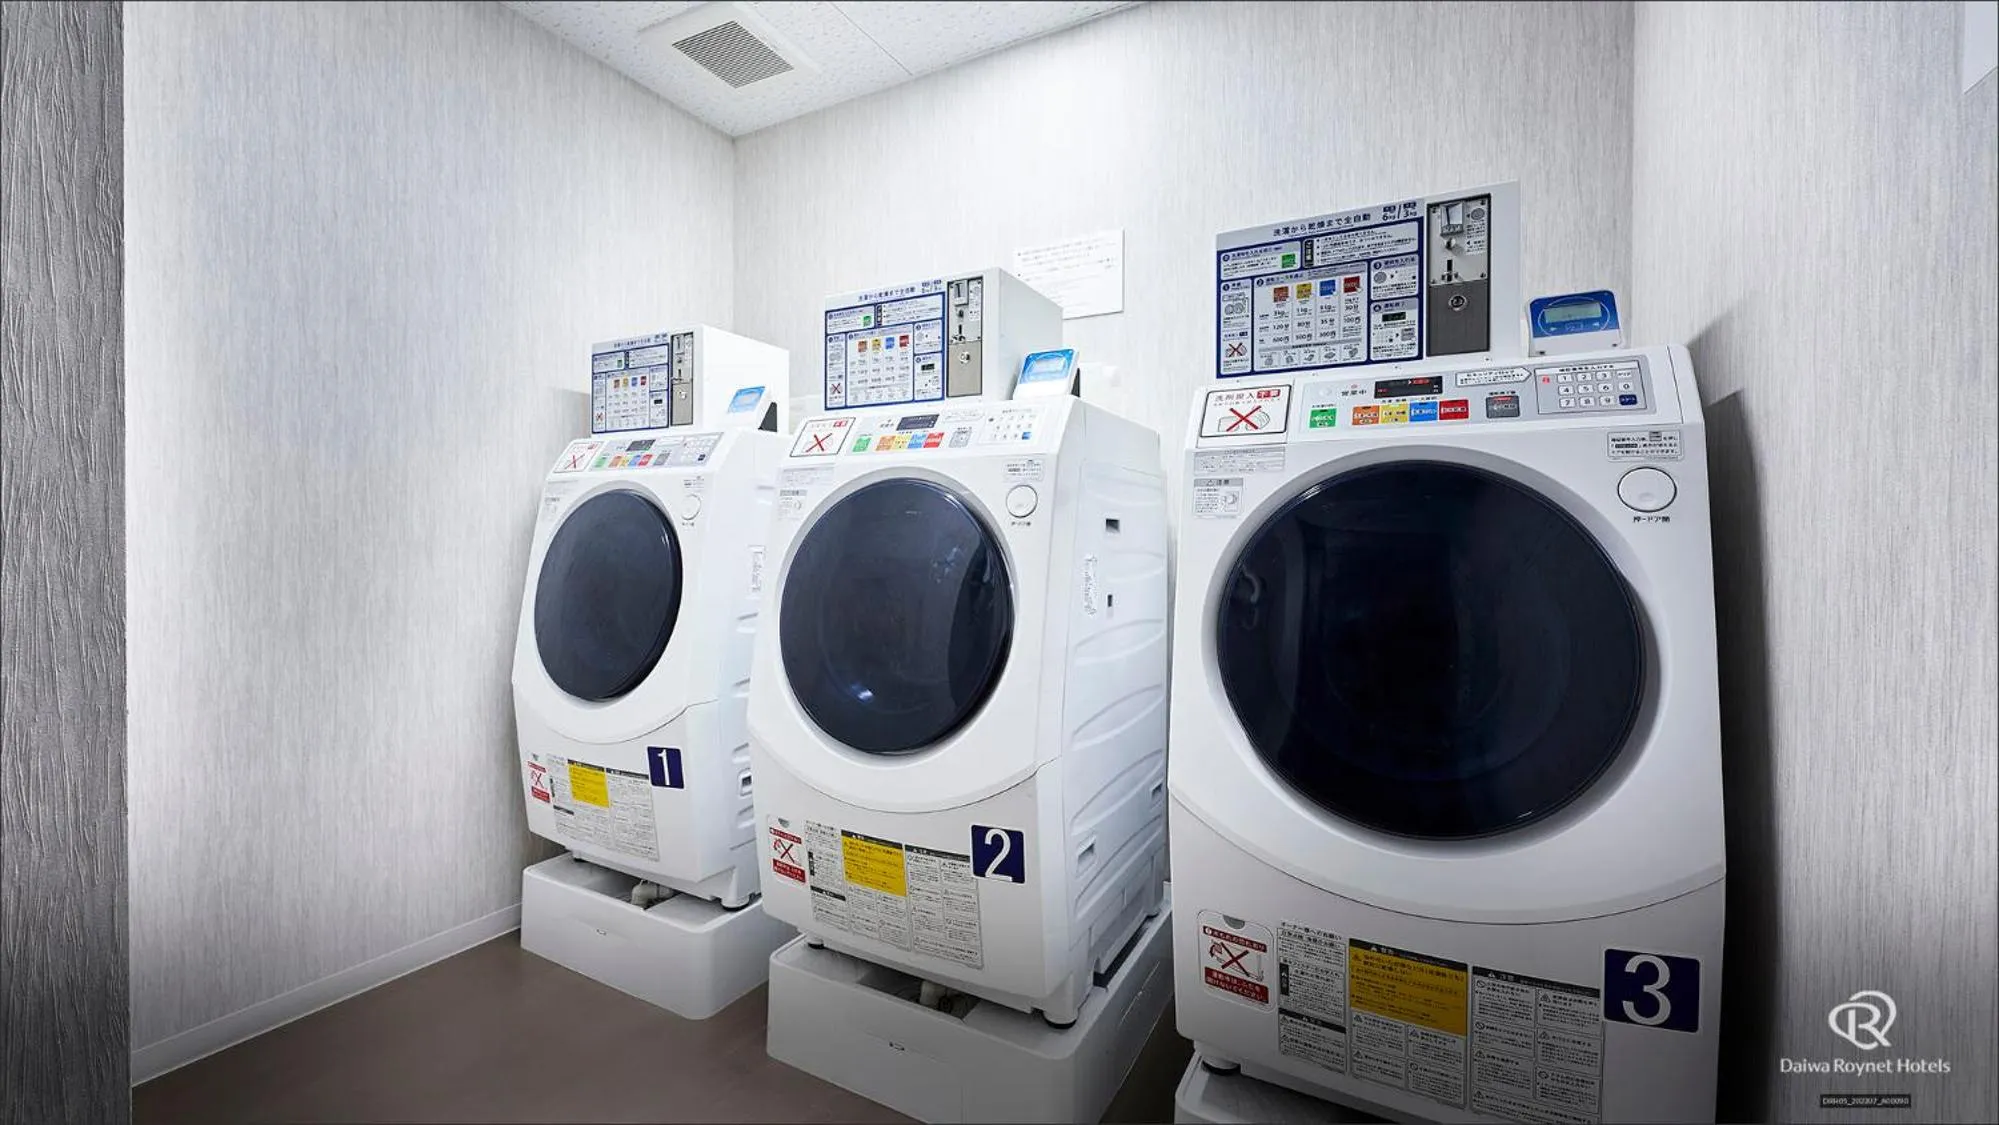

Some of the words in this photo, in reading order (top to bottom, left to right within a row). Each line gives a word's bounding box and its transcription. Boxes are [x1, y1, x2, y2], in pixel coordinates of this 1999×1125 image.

[658, 749, 670, 786] 1
[984, 828, 1012, 882] 2
[1622, 954, 1672, 1025] 3
